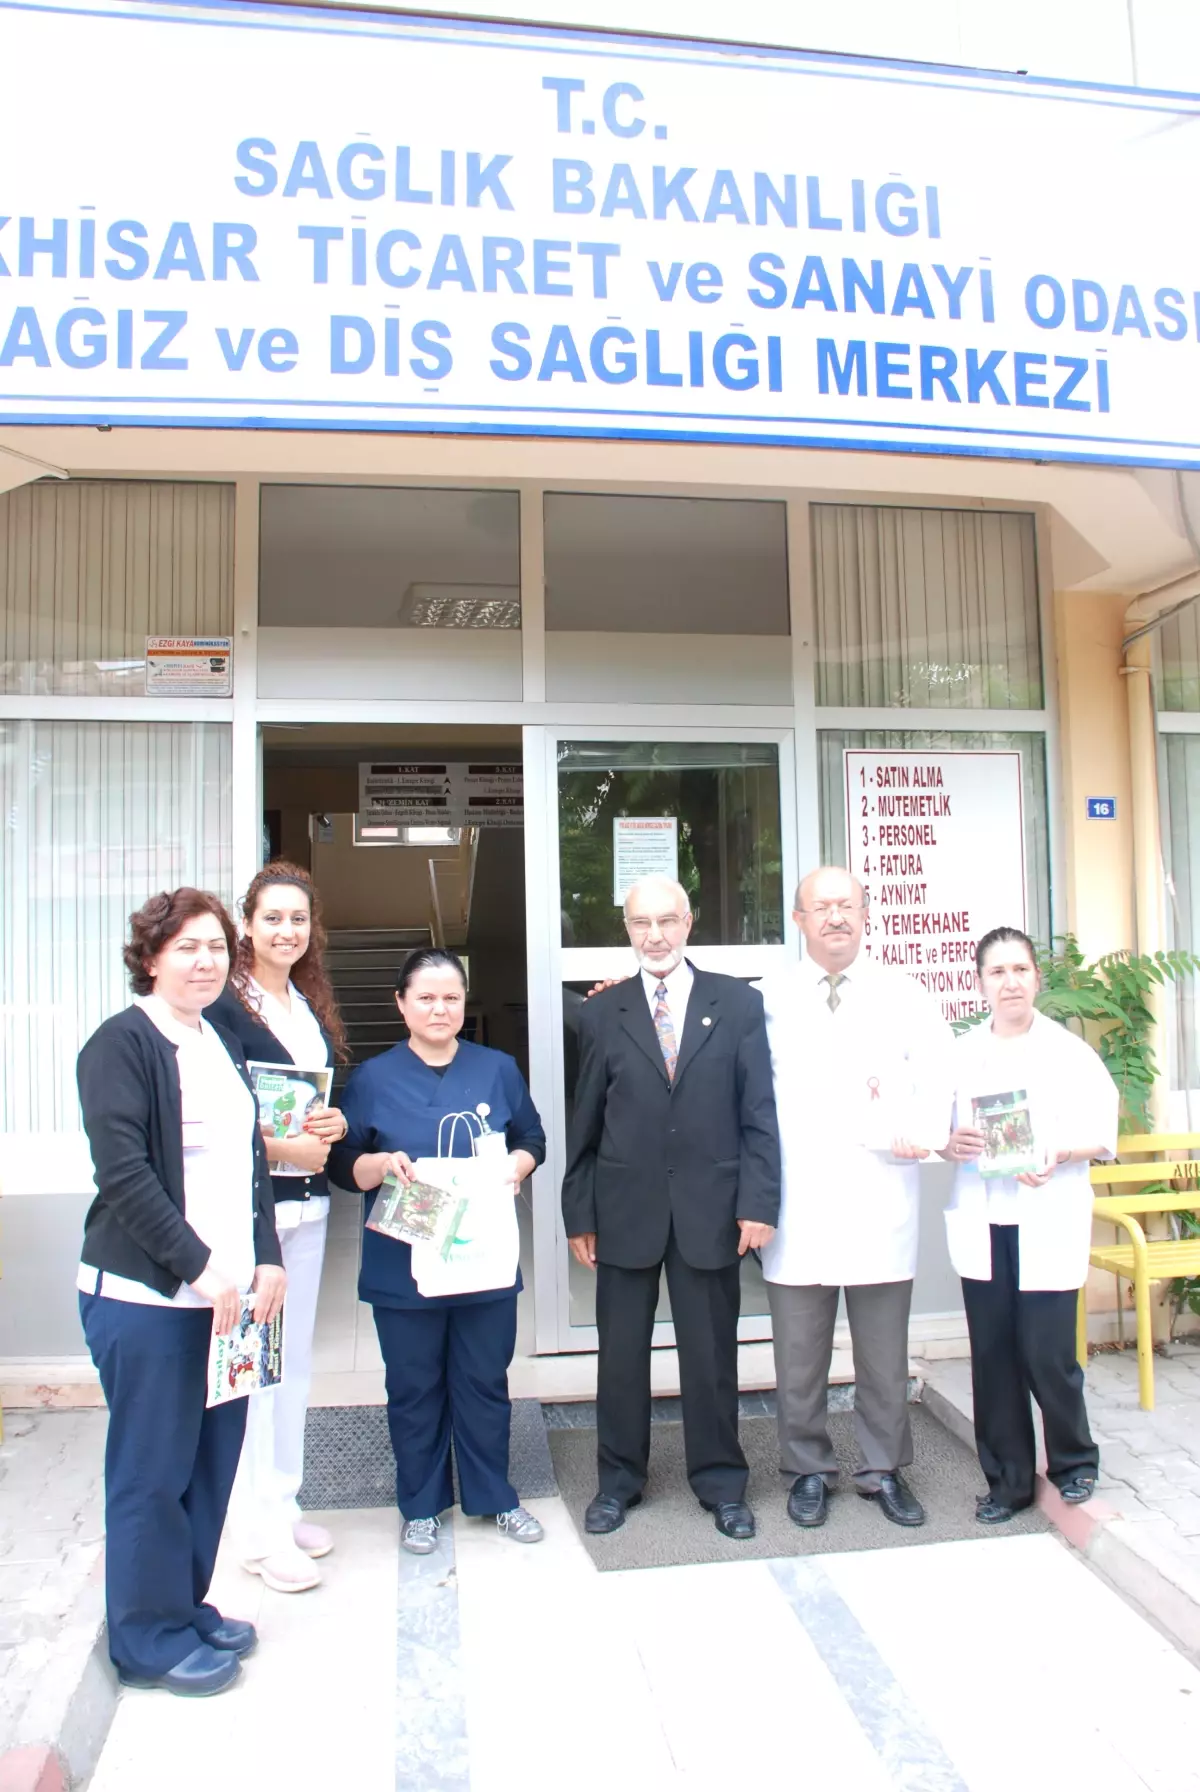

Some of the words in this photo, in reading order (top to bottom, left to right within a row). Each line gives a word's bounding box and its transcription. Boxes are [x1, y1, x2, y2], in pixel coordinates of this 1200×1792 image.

[541, 76, 668, 140] T.C.
[234, 132, 515, 211] SAĞLIK
[552, 158, 942, 239] BAKANLIĞI
[0, 206, 260, 282] HİSAR
[298, 215, 621, 299] TİCARET
[646, 260, 724, 304] ve
[747, 252, 996, 323] SANAYİ
[0, 297, 189, 371] AĞIZ
[215, 326, 299, 373] ve
[330, 304, 454, 393] DİŞ
[489, 316, 782, 393] SAĞLIĞI
[816, 338, 1111, 413] MERKEZİ
[860, 766, 865, 788] 1
[876, 766, 909, 788] SATIN
[913, 766, 944, 788] ALMA
[861, 795, 868, 817] 2
[878, 792, 951, 817] MUTEMETLİK
[1093, 802, 1110, 816] 16
[862, 824, 869, 847] 3
[879, 824, 937, 846] PERSONEL
[863, 854, 870, 877] 4
[880, 853, 923, 876] FATURA
[881, 881, 927, 906] AYNİYAT
[882, 911, 970, 936] YEMEKHANE
[882, 940, 922, 965] KALİTE
[926, 947, 938, 964] ve
[941, 940, 980, 963] PERFO
[906, 969, 954, 993] SİYON
